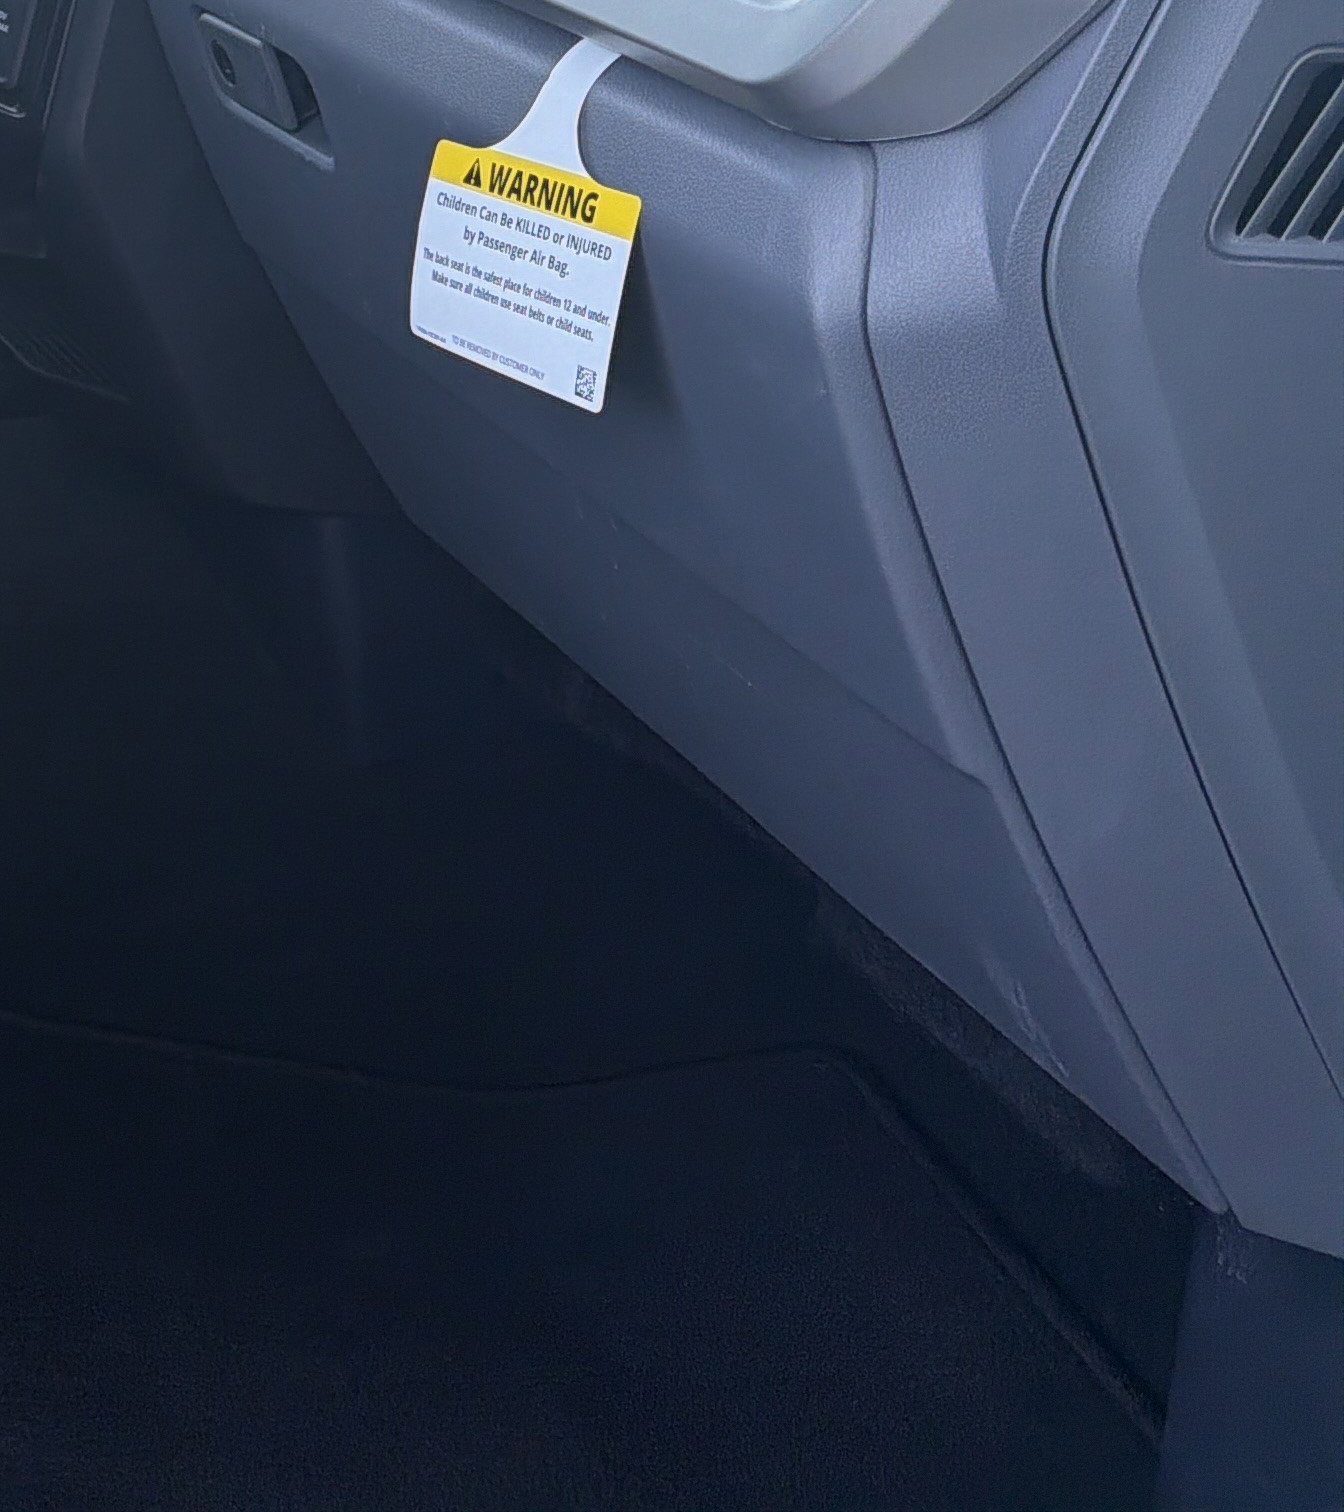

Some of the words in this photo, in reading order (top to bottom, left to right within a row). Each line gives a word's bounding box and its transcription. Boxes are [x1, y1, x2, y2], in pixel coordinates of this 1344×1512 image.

[489, 162, 599, 223] WARNING
[437, 192, 478, 218] Children
[479, 206, 498, 223] Can
[500, 212, 513, 229] Be
[515, 218, 551, 240] KILLED
[553, 232, 565, 245] or
[566, 233, 612, 261] INJURED
[463, 225, 476, 245] by
[477, 231, 529, 261] Passenger
[530, 249, 546, 266] Air
[548, 255, 570, 278] Bag.
[423, 247, 434, 262] The
[435, 251, 450, 267] back
[450, 260, 464, 272] seat
[465, 262, 471, 275] is
[472, 265, 483, 279] the
[483, 271, 503, 287] safest
[503, 277, 521, 293] place
[522, 282, 533, 297] for
[534, 288, 561, 308] children
[563, 299, 572, 312] 12
[572, 304, 587, 318] and
[432, 268, 449, 286] Make
[449, 279, 463, 292] sure
[473, 286, 499, 305] children
[513, 303, 528, 316] seat
[529, 305, 545, 323] belts
[546, 315, 555, 326] or
[555, 316, 573, 333] child
